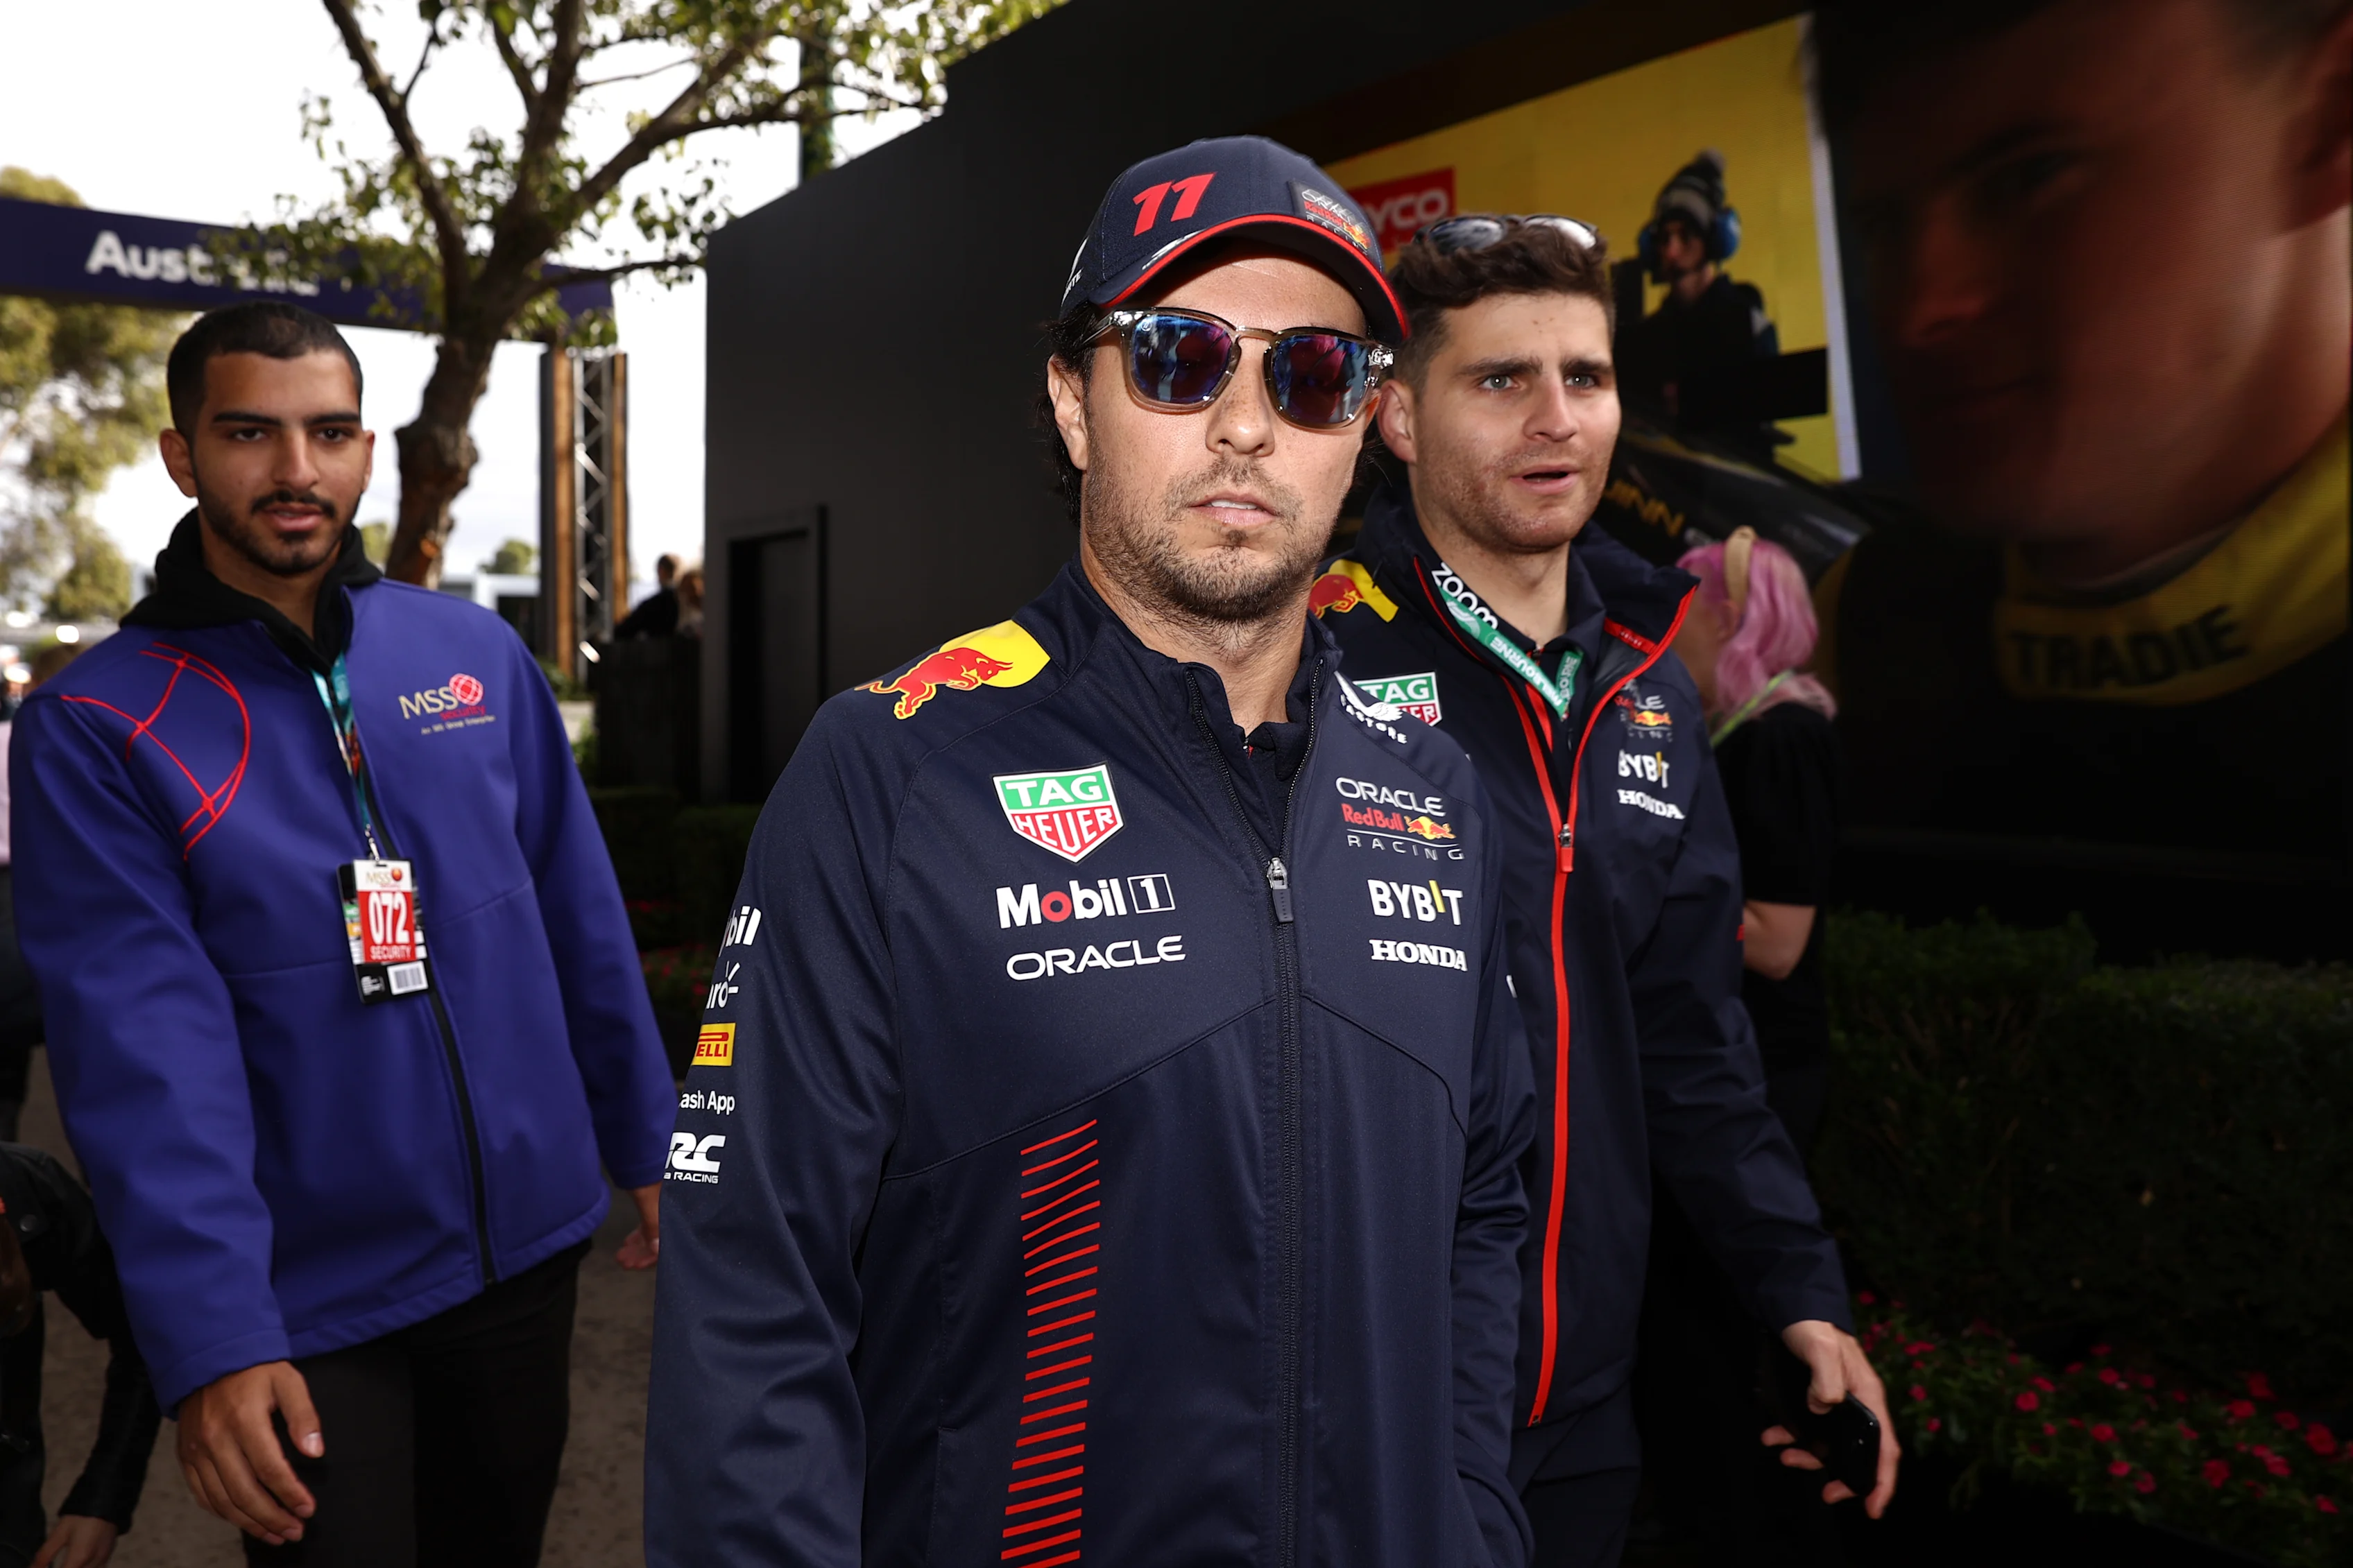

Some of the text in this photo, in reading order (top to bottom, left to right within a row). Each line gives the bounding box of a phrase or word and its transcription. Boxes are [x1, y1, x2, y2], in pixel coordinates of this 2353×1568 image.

[1133, 171, 1217, 236] 11
[1362, 187, 1450, 234] YCO
[2008, 605, 2250, 689] TRADIE
[398, 686, 459, 720] MSS
[1005, 775, 1103, 807] TAG
[1336, 777, 1446, 817] ORACLE
[1617, 789, 1686, 820] HONDA
[1014, 807, 1115, 854] HEUER
[1347, 834, 1465, 861] RACING
[368, 890, 410, 945] 072
[996, 877, 1128, 929] Mobil
[1367, 879, 1464, 926] BYBIT
[719, 905, 762, 957] bil
[370, 945, 412, 960] SECURITY
[1007, 935, 1186, 981] ORACLE
[1369, 939, 1469, 972] HONDA
[696, 1043, 728, 1057] ELLI
[678, 1089, 736, 1116] ash App
[665, 1132, 726, 1173] RC
[674, 1171, 719, 1184] RACING
